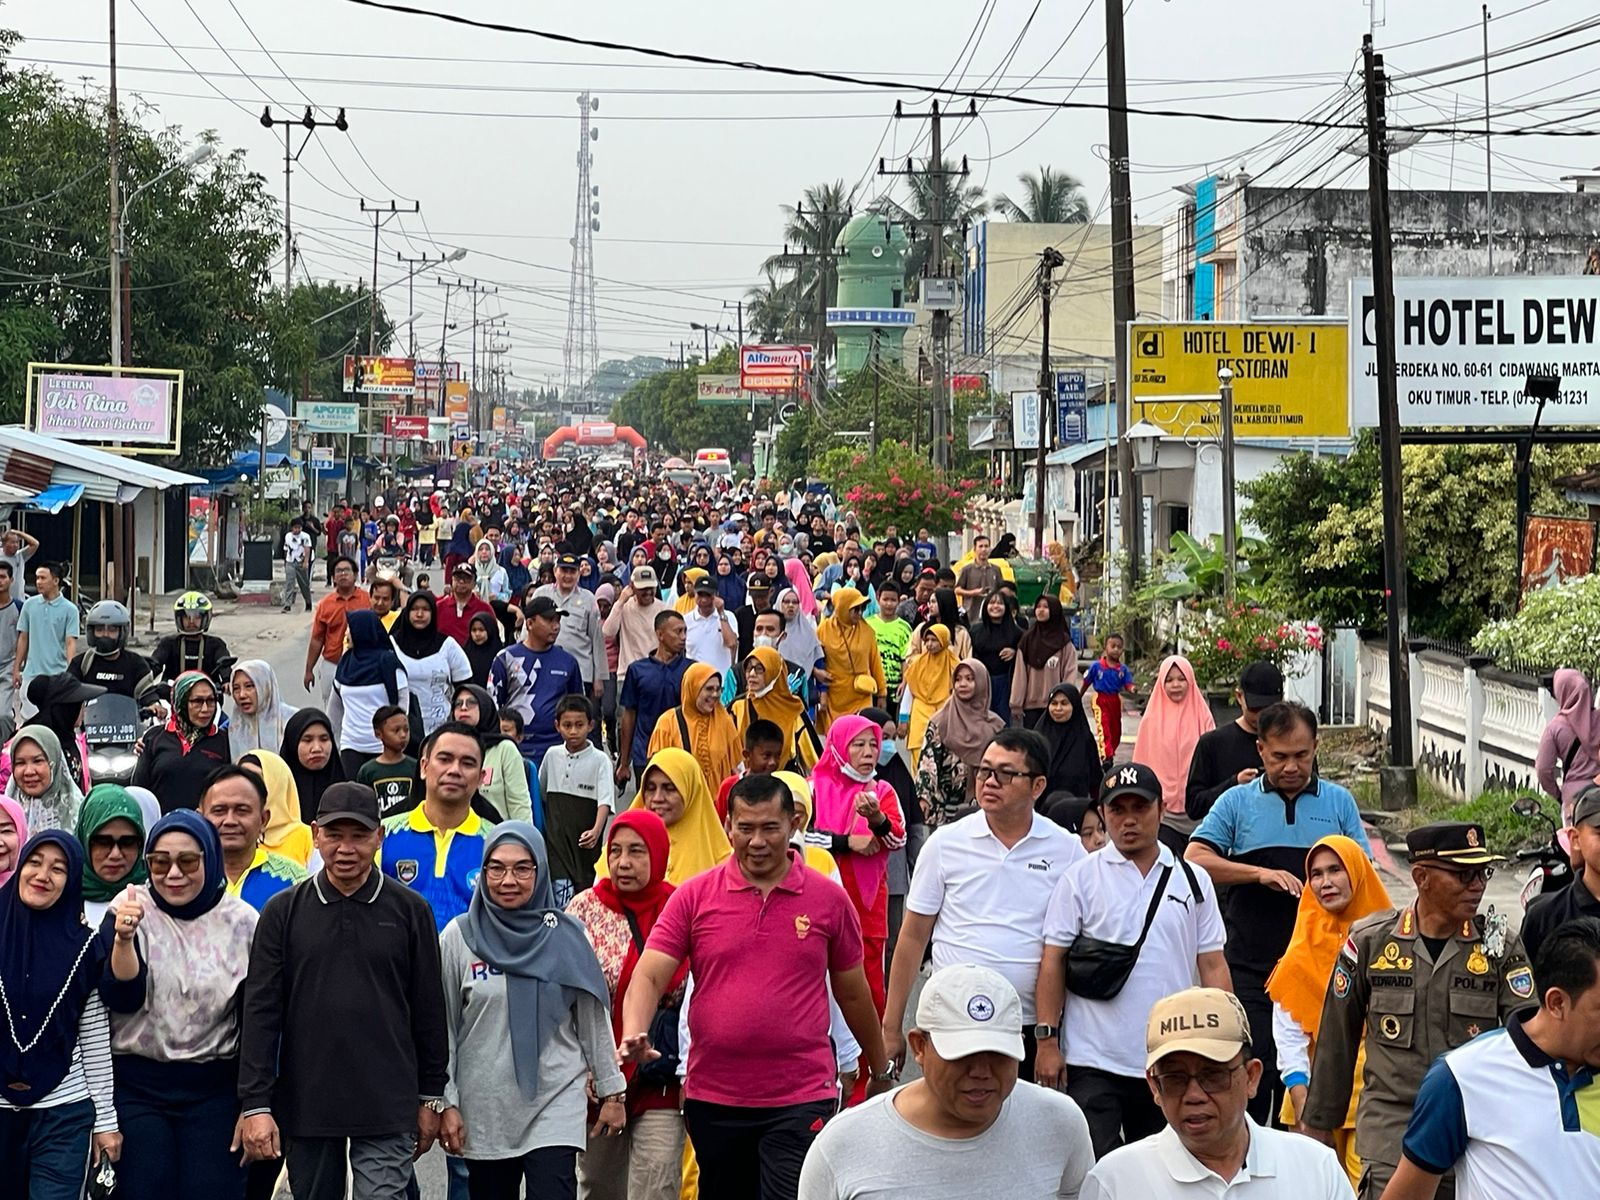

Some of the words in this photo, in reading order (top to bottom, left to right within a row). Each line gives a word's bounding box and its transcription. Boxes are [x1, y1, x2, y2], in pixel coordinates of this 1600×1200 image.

[1404, 299, 1515, 346] HOTEL
[1184, 331, 1231, 354] HOTEL
[747, 353, 798, 364] Alfamart
[1395, 362, 1439, 377] ERDEKA
[1442, 362, 1461, 377] NO.
[1464, 362, 1493, 377] 60-61
[1500, 362, 1559, 378] CIDAWANG
[1562, 362, 1600, 376] MARTA
[49, 378, 94, 391] LESEHAN
[1058, 374, 1084, 382] DEPOT
[82, 393, 128, 413] Rina
[1408, 390, 1432, 405] OKU
[1435, 390, 1471, 405] TIMUR
[1480, 390, 1510, 405] TELP.
[313, 405, 356, 414] APOTEK
[47, 414, 77, 428] Khas
[1279, 415, 1304, 425] TIMUR
[1120, 767, 1138, 785] NY
[1028, 863, 1047, 871] PUMA
[1371, 975, 1413, 988] EDWARD
[1454, 976, 1477, 990] POL
[1160, 1013, 1219, 1036] MILLS
